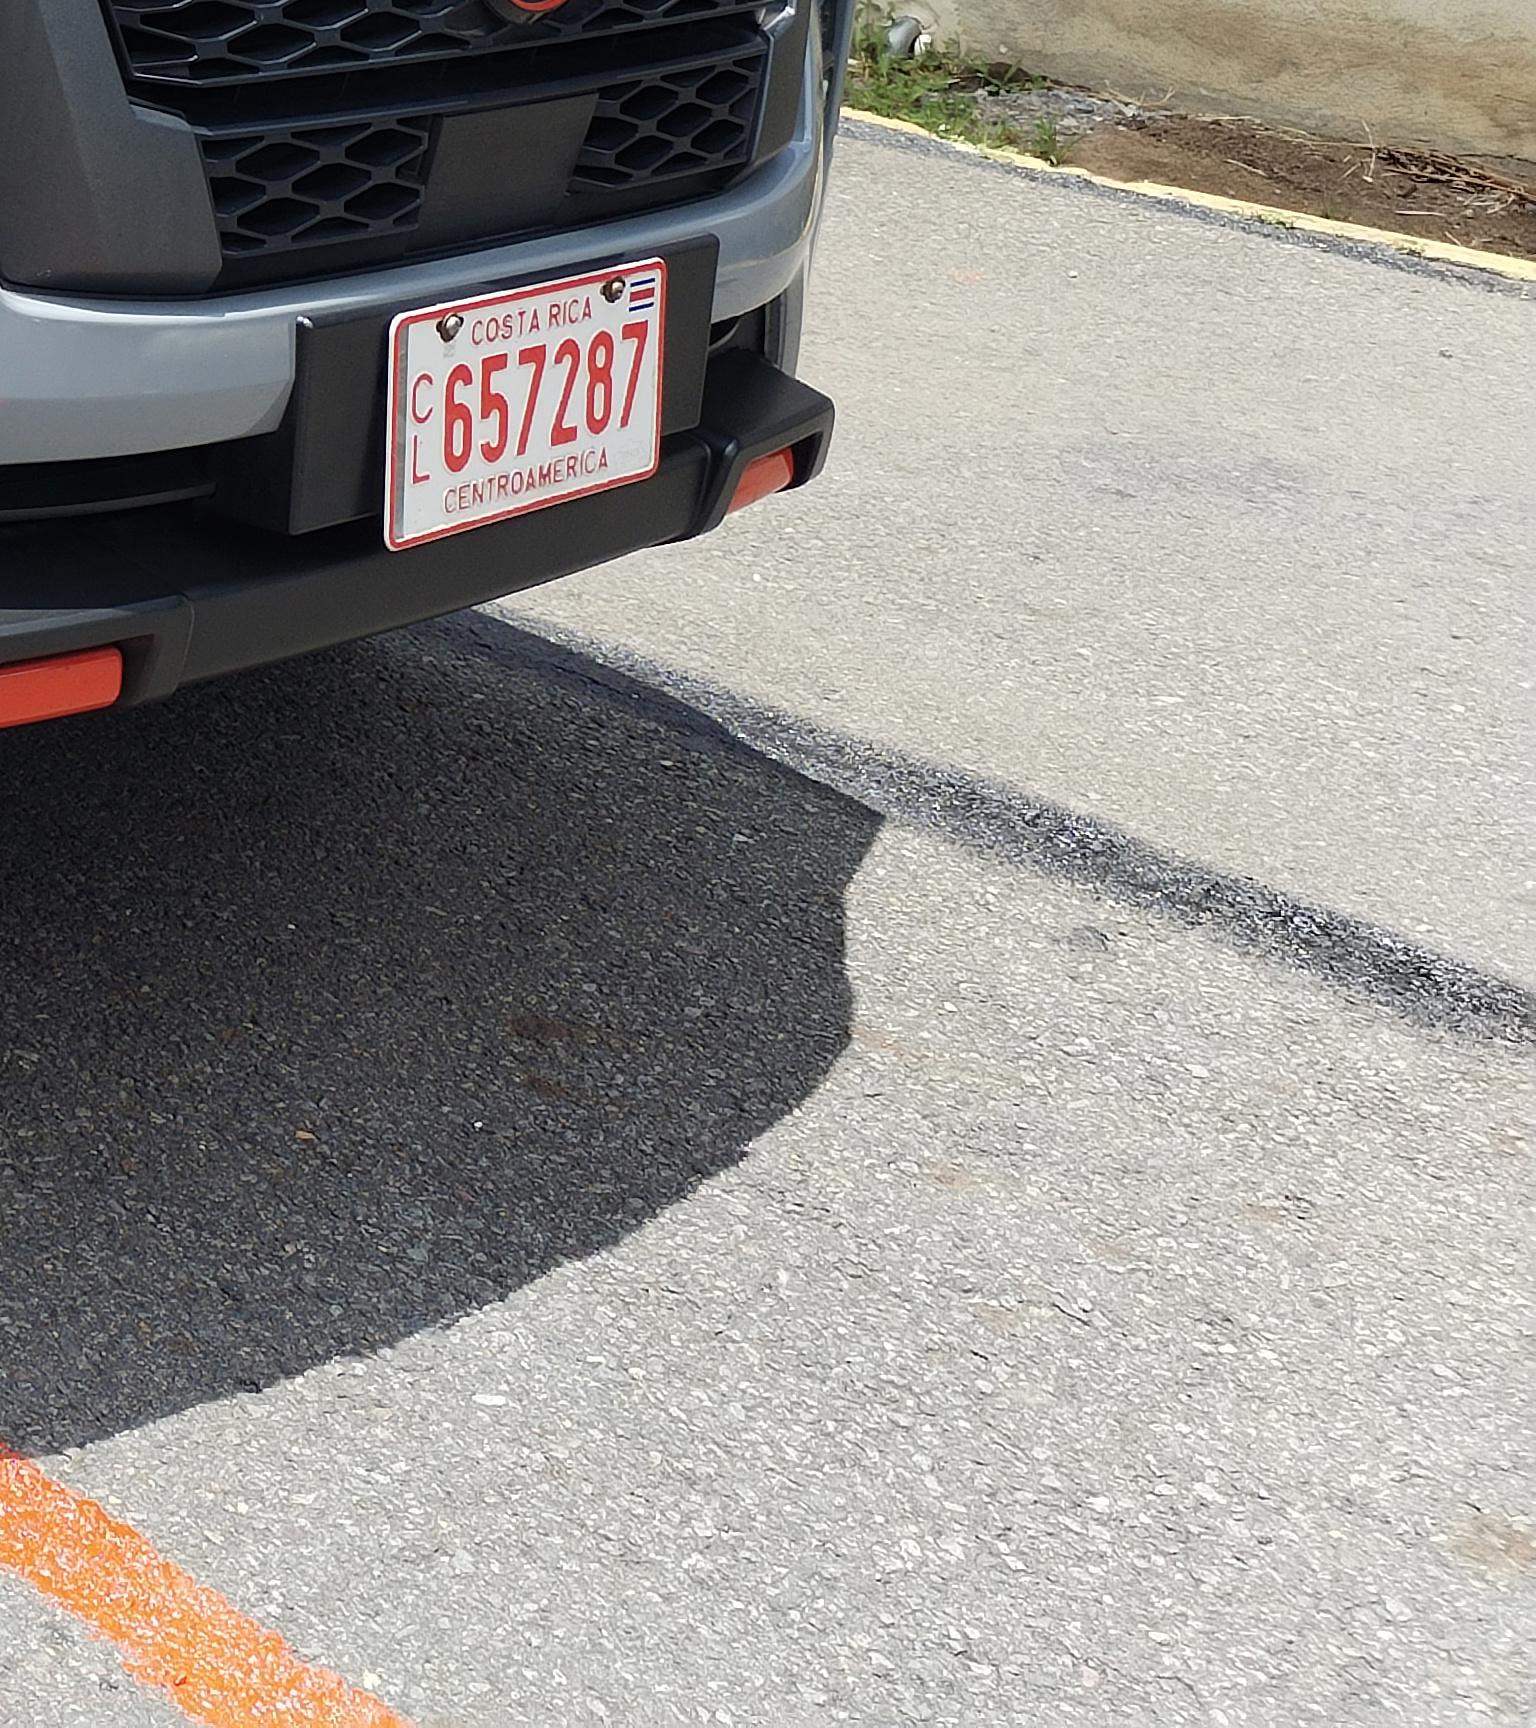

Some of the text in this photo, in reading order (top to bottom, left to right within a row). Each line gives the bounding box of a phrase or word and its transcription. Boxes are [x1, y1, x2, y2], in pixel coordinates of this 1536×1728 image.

[471, 296, 593, 347] COSTA RICA
[442, 319, 649, 473] 657287
[443, 446, 609, 514] CENTROAMERICA
